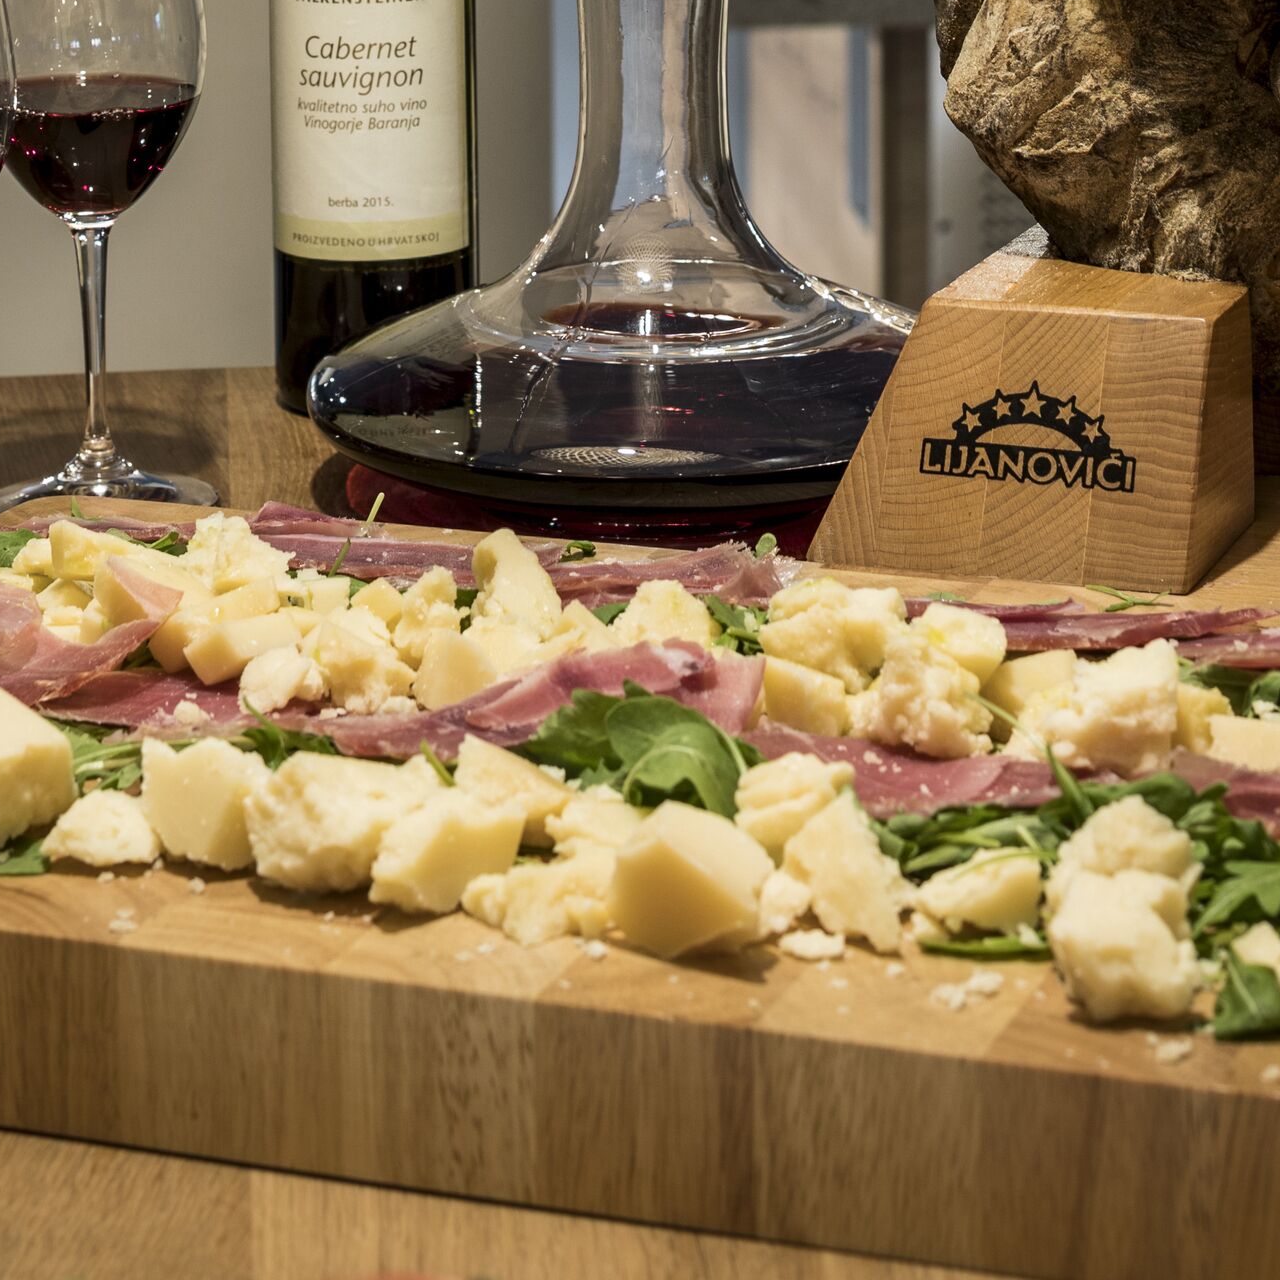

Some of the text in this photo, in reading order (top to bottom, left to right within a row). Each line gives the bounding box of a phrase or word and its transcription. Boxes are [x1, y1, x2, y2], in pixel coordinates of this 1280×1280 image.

[305, 35, 417, 60] Cabernet
[299, 65, 423, 96] sauvignon
[297, 97, 427, 114] kvalitetno suho vino
[303, 114, 421, 134] Vinogorje Baranja
[328, 196, 395, 208] berba 2015.
[292, 232, 366, 248] PROIZVEDENO
